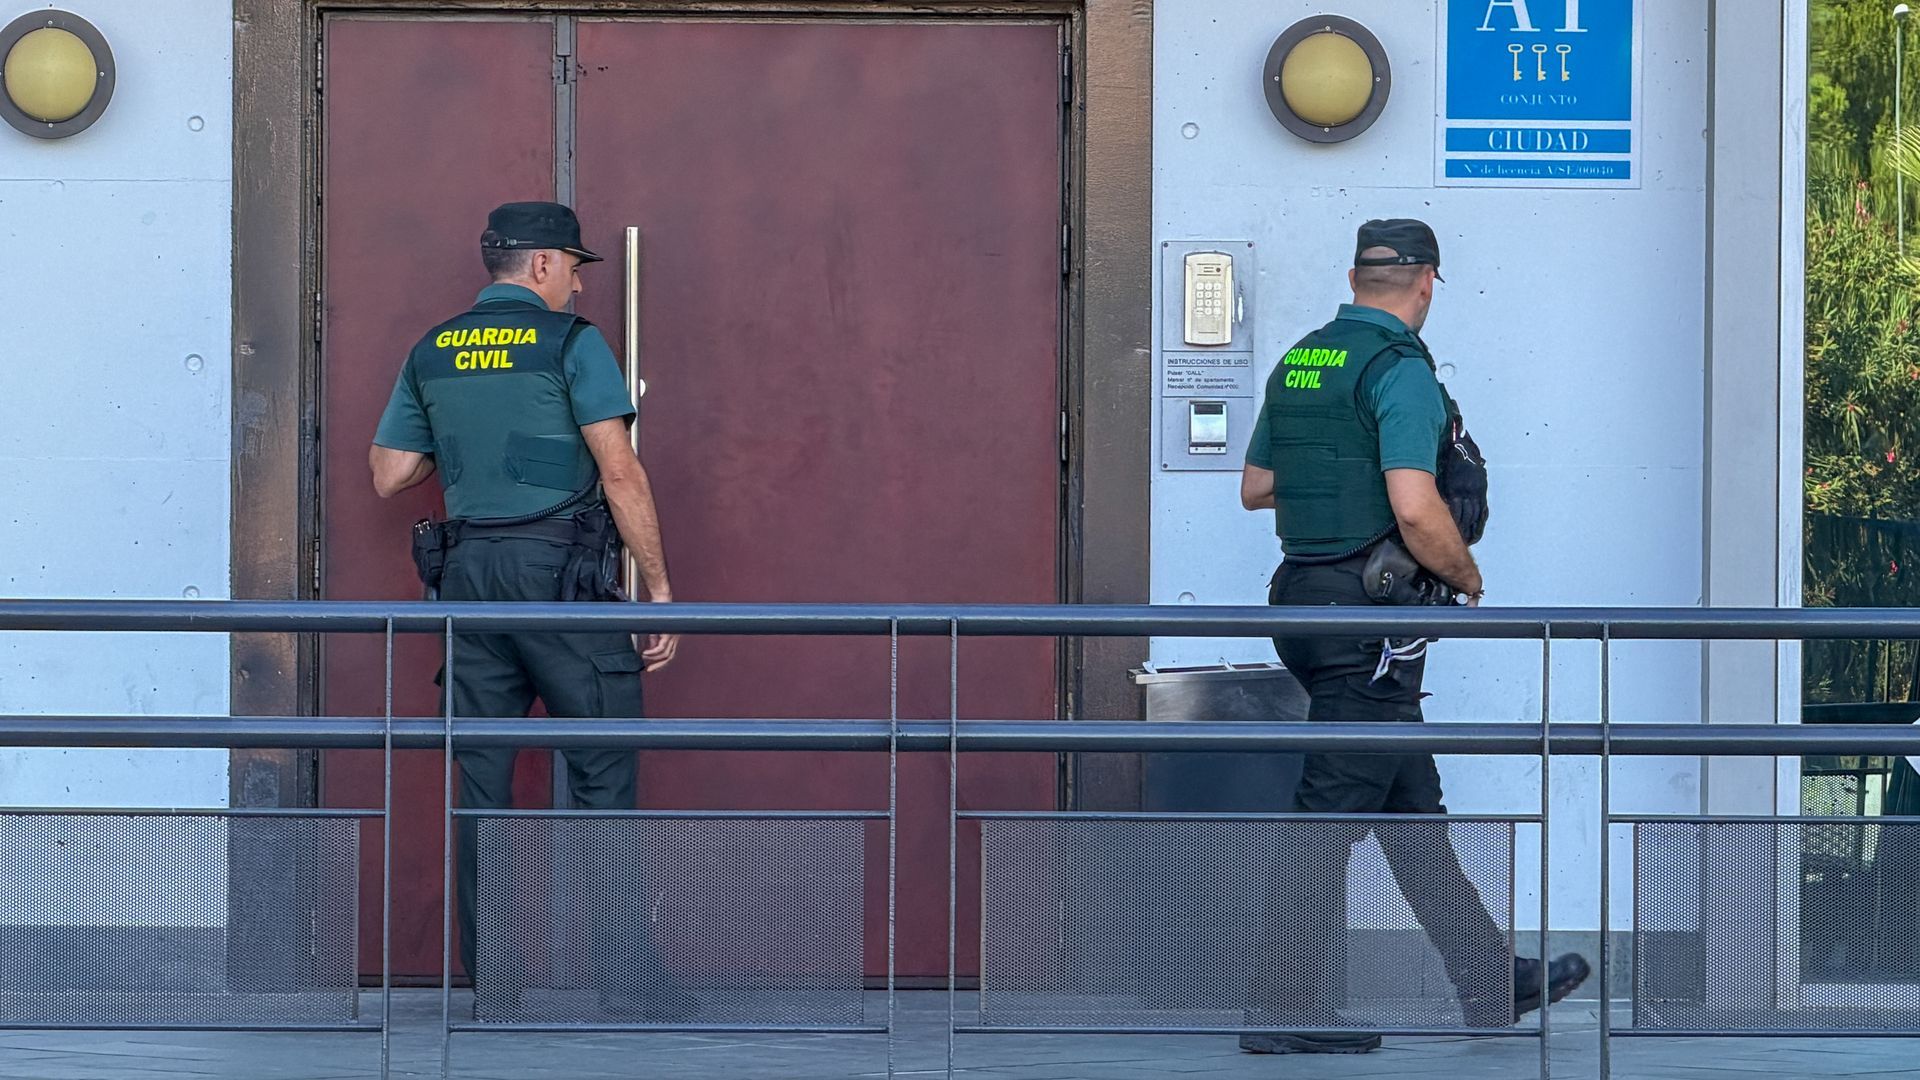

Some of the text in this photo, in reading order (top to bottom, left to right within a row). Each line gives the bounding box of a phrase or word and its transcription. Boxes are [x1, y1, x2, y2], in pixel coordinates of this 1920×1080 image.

[1500, 94, 1577, 105] CONJUNTO
[1488, 130, 1588, 151] CIUDAD
[1480, 163, 1494, 175] de
[1497, 164, 1541, 175] licencia
[435, 327, 537, 348] GUARDIA
[455, 350, 513, 370] CIVIL
[1283, 347, 1348, 368] GUARDIA
[1285, 369, 1321, 389] CIVIL
